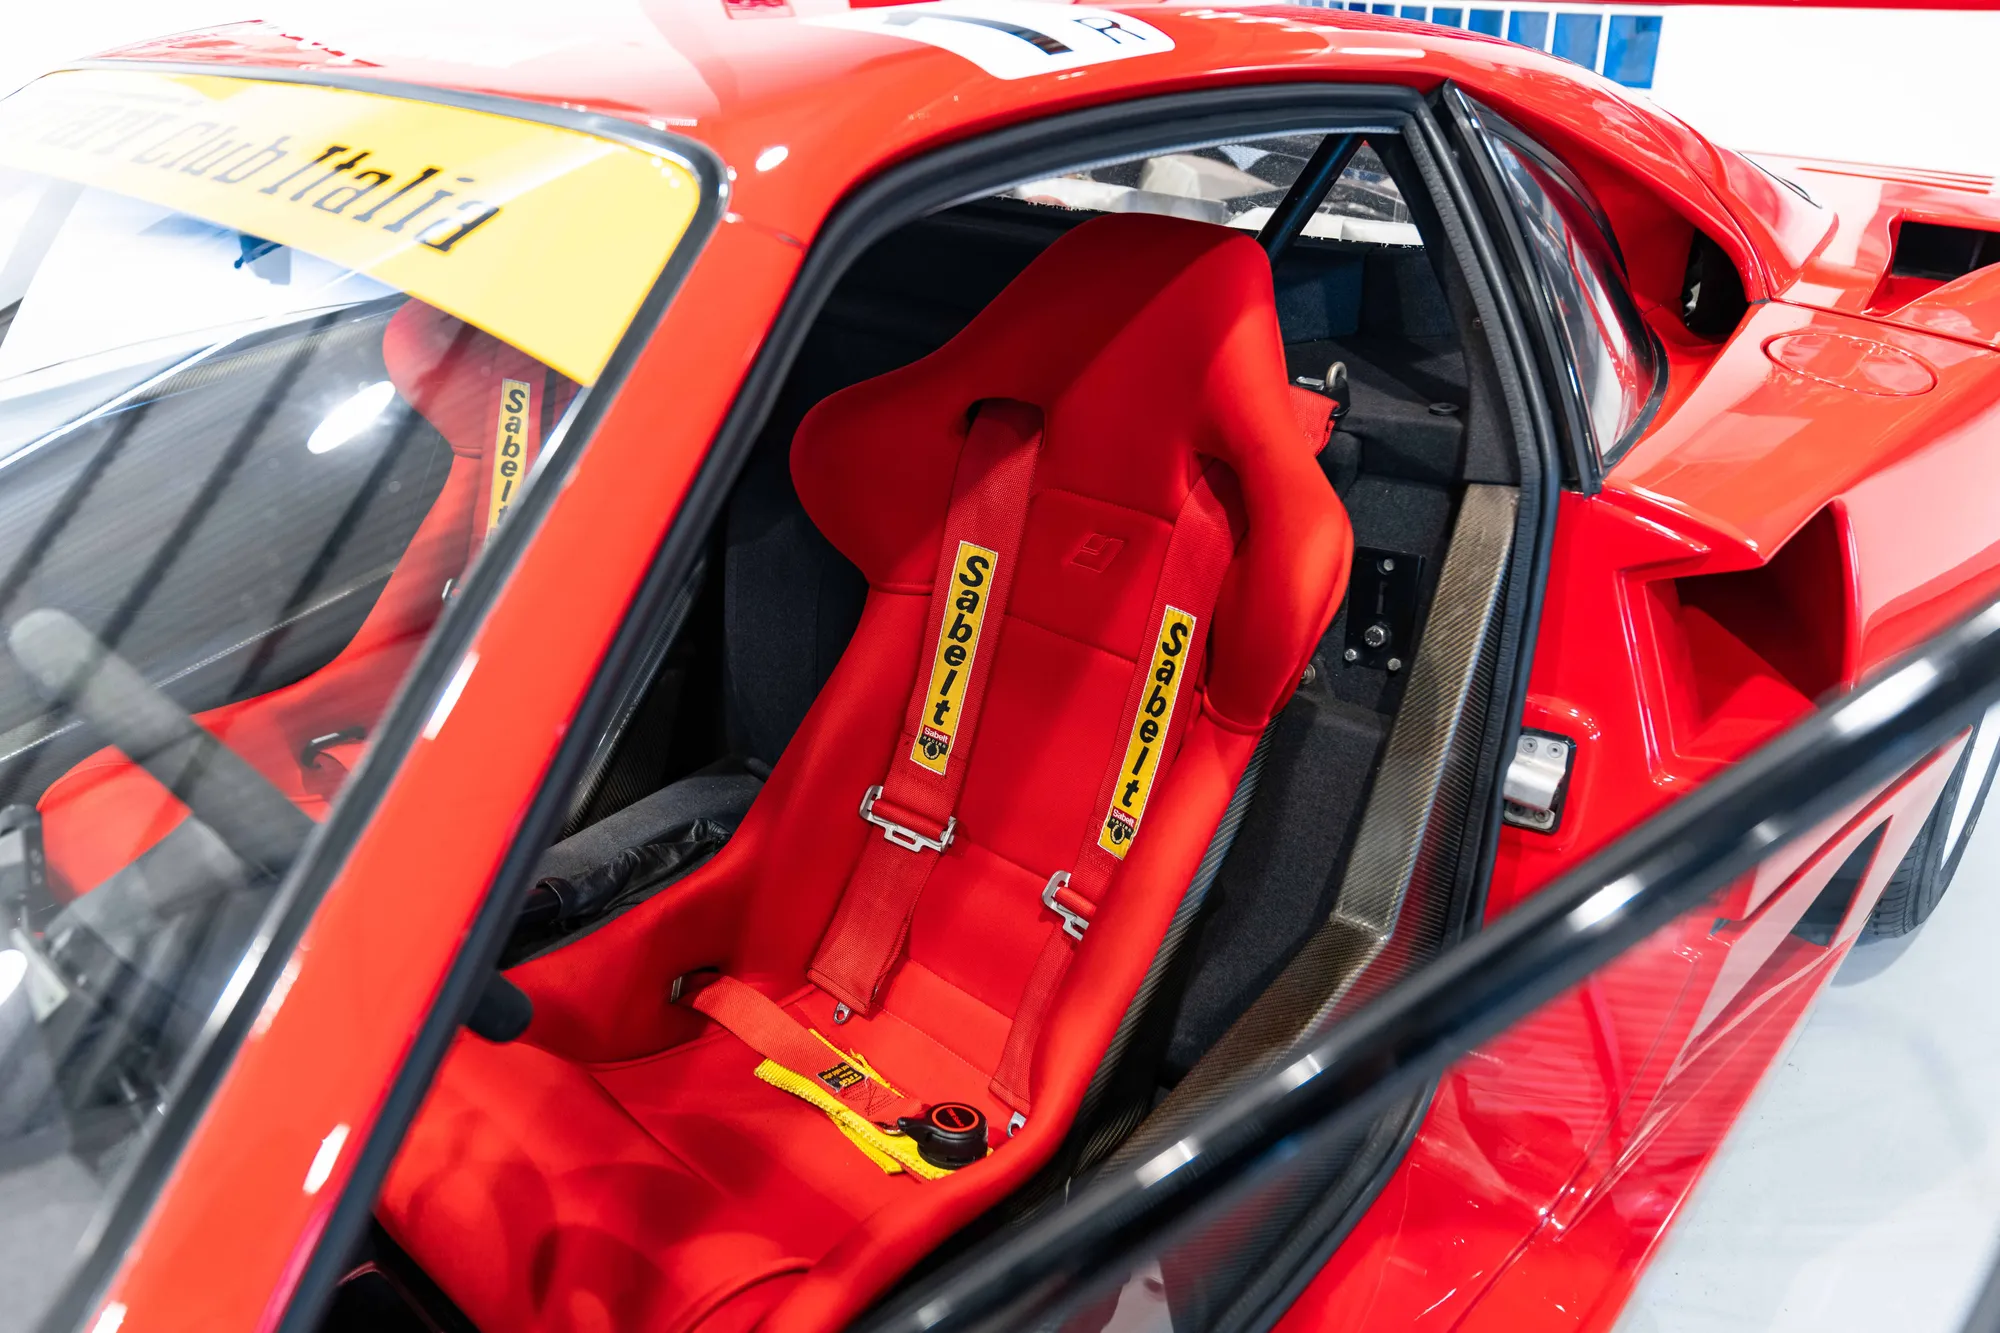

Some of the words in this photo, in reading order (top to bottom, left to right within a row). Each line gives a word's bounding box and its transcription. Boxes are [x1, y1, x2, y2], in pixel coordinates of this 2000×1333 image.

[1073, 17, 1146, 44] R
[129, 120, 293, 184] Club
[258, 145, 500, 252] Italia
[933, 555, 989, 726] Sabelt
[924, 727, 949, 744] Sabelt
[1122, 622, 1188, 808] Sabelt
[1113, 808, 1135, 828] Sabelt
